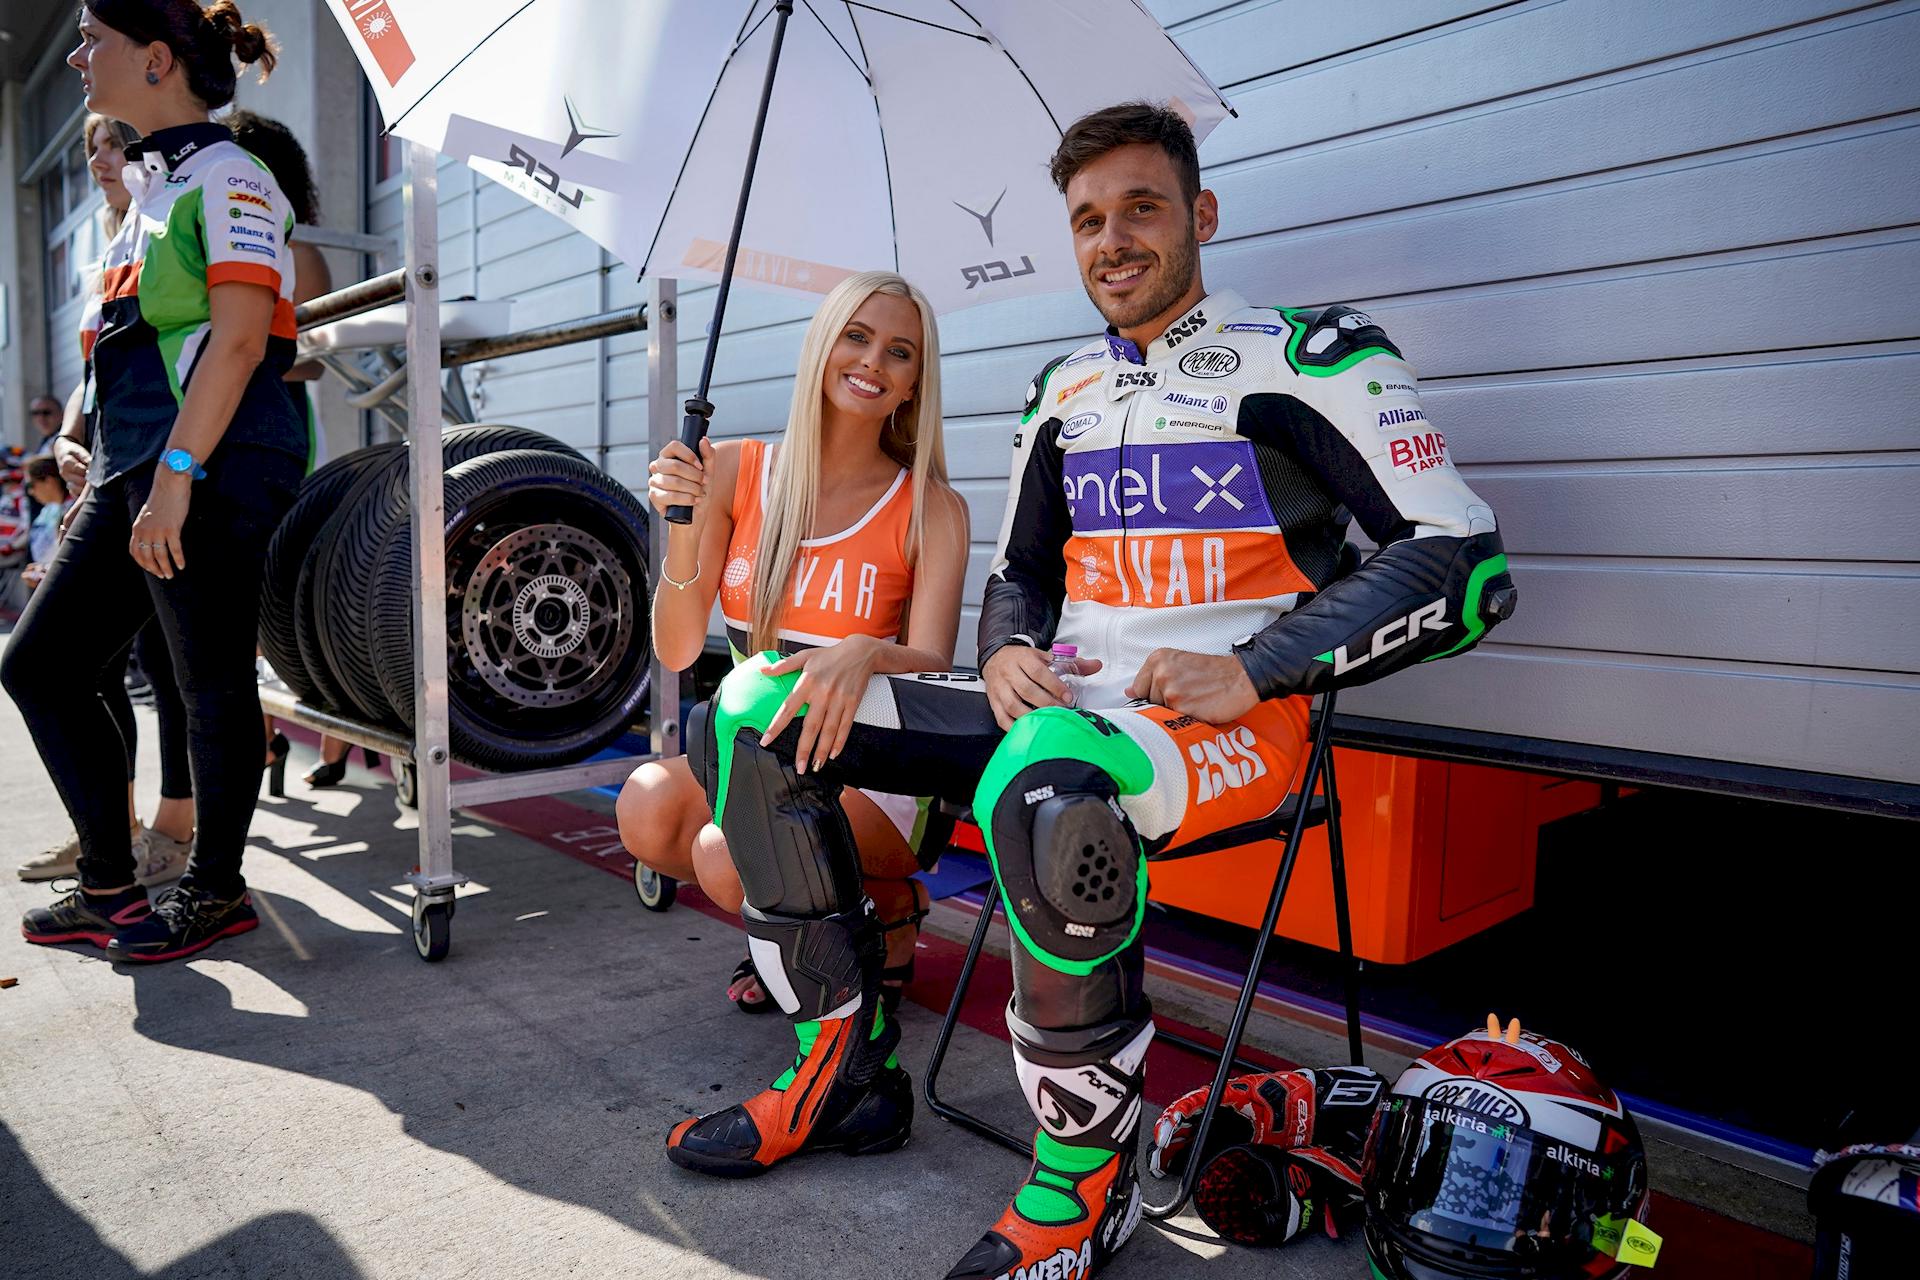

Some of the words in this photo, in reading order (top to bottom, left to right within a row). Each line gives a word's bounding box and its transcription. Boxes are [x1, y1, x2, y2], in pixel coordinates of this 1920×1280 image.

[172, 141, 198, 161] LCR
[227, 177, 261, 193] enel
[229, 225, 264, 239] Allianz
[1233, 325, 1276, 333] MICHELIN
[1183, 351, 1236, 373] PREMIER
[1163, 392, 1209, 409] Allianz
[1066, 416, 1093, 434] COMAL
[1113, 537, 1227, 606] IVAR
[794, 556, 878, 620] VAR
[1334, 597, 1453, 677] LCR
[1431, 1109, 1487, 1134] alkiria
[1546, 1145, 1600, 1177] alkiria
